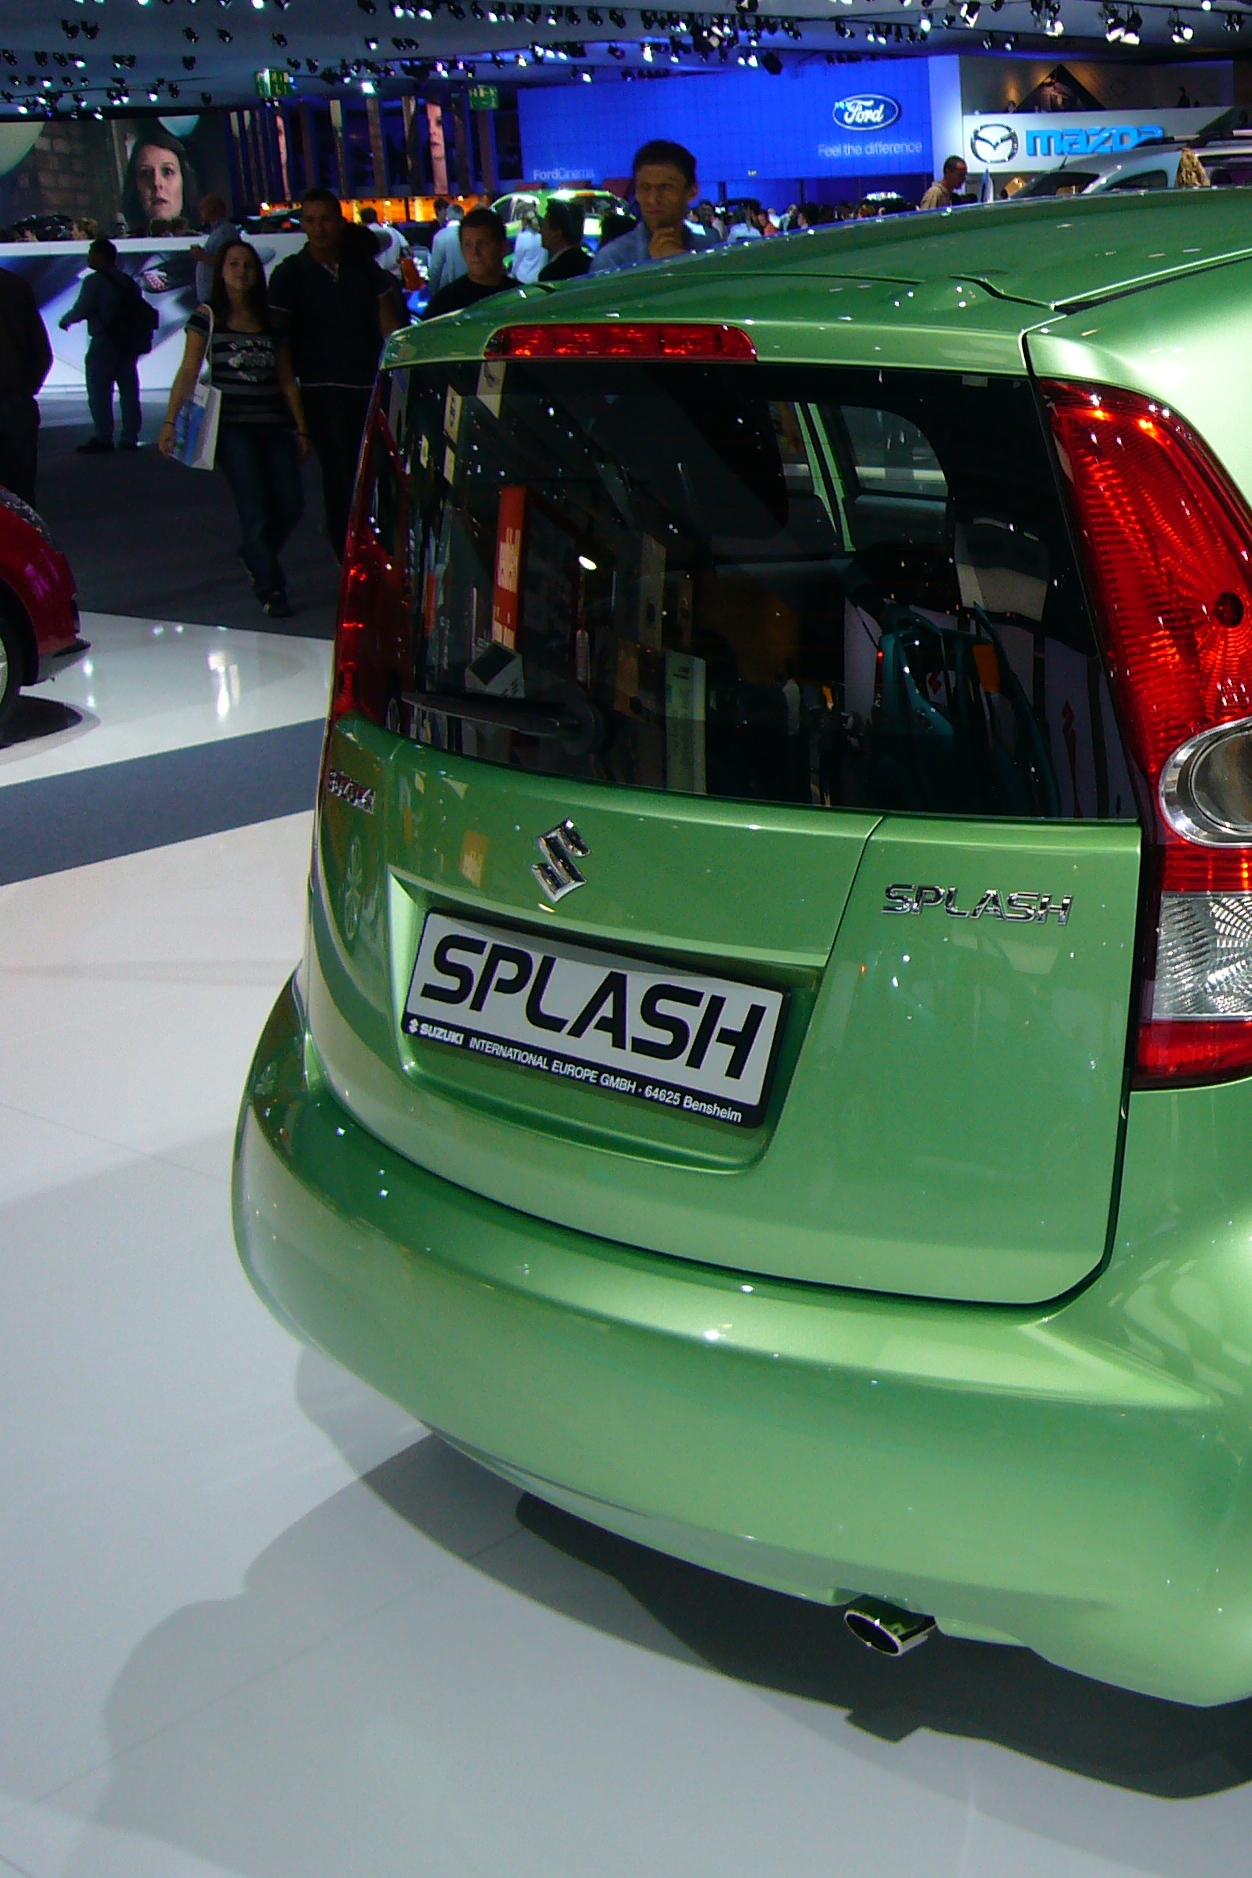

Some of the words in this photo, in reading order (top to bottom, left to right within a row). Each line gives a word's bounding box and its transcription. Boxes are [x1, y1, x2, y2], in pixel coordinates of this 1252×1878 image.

[844, 99, 885, 125] Ford
[818, 143, 842, 157] Feel
[843, 142, 862, 156] the
[864, 140, 923, 156] difference
[881, 884, 1074, 926] SPLASH
[420, 933, 768, 1081] SPLASH
[420, 1022, 465, 1046] SUZUKI
[469, 1036, 549, 1070] INTERNATIONAL
[551, 1059, 600, 1084] EUROPE
[600, 1072, 637, 1094] GMBH
[644, 1084, 681, 1106] 64625
[682, 1095, 742, 1124] Bensheim
